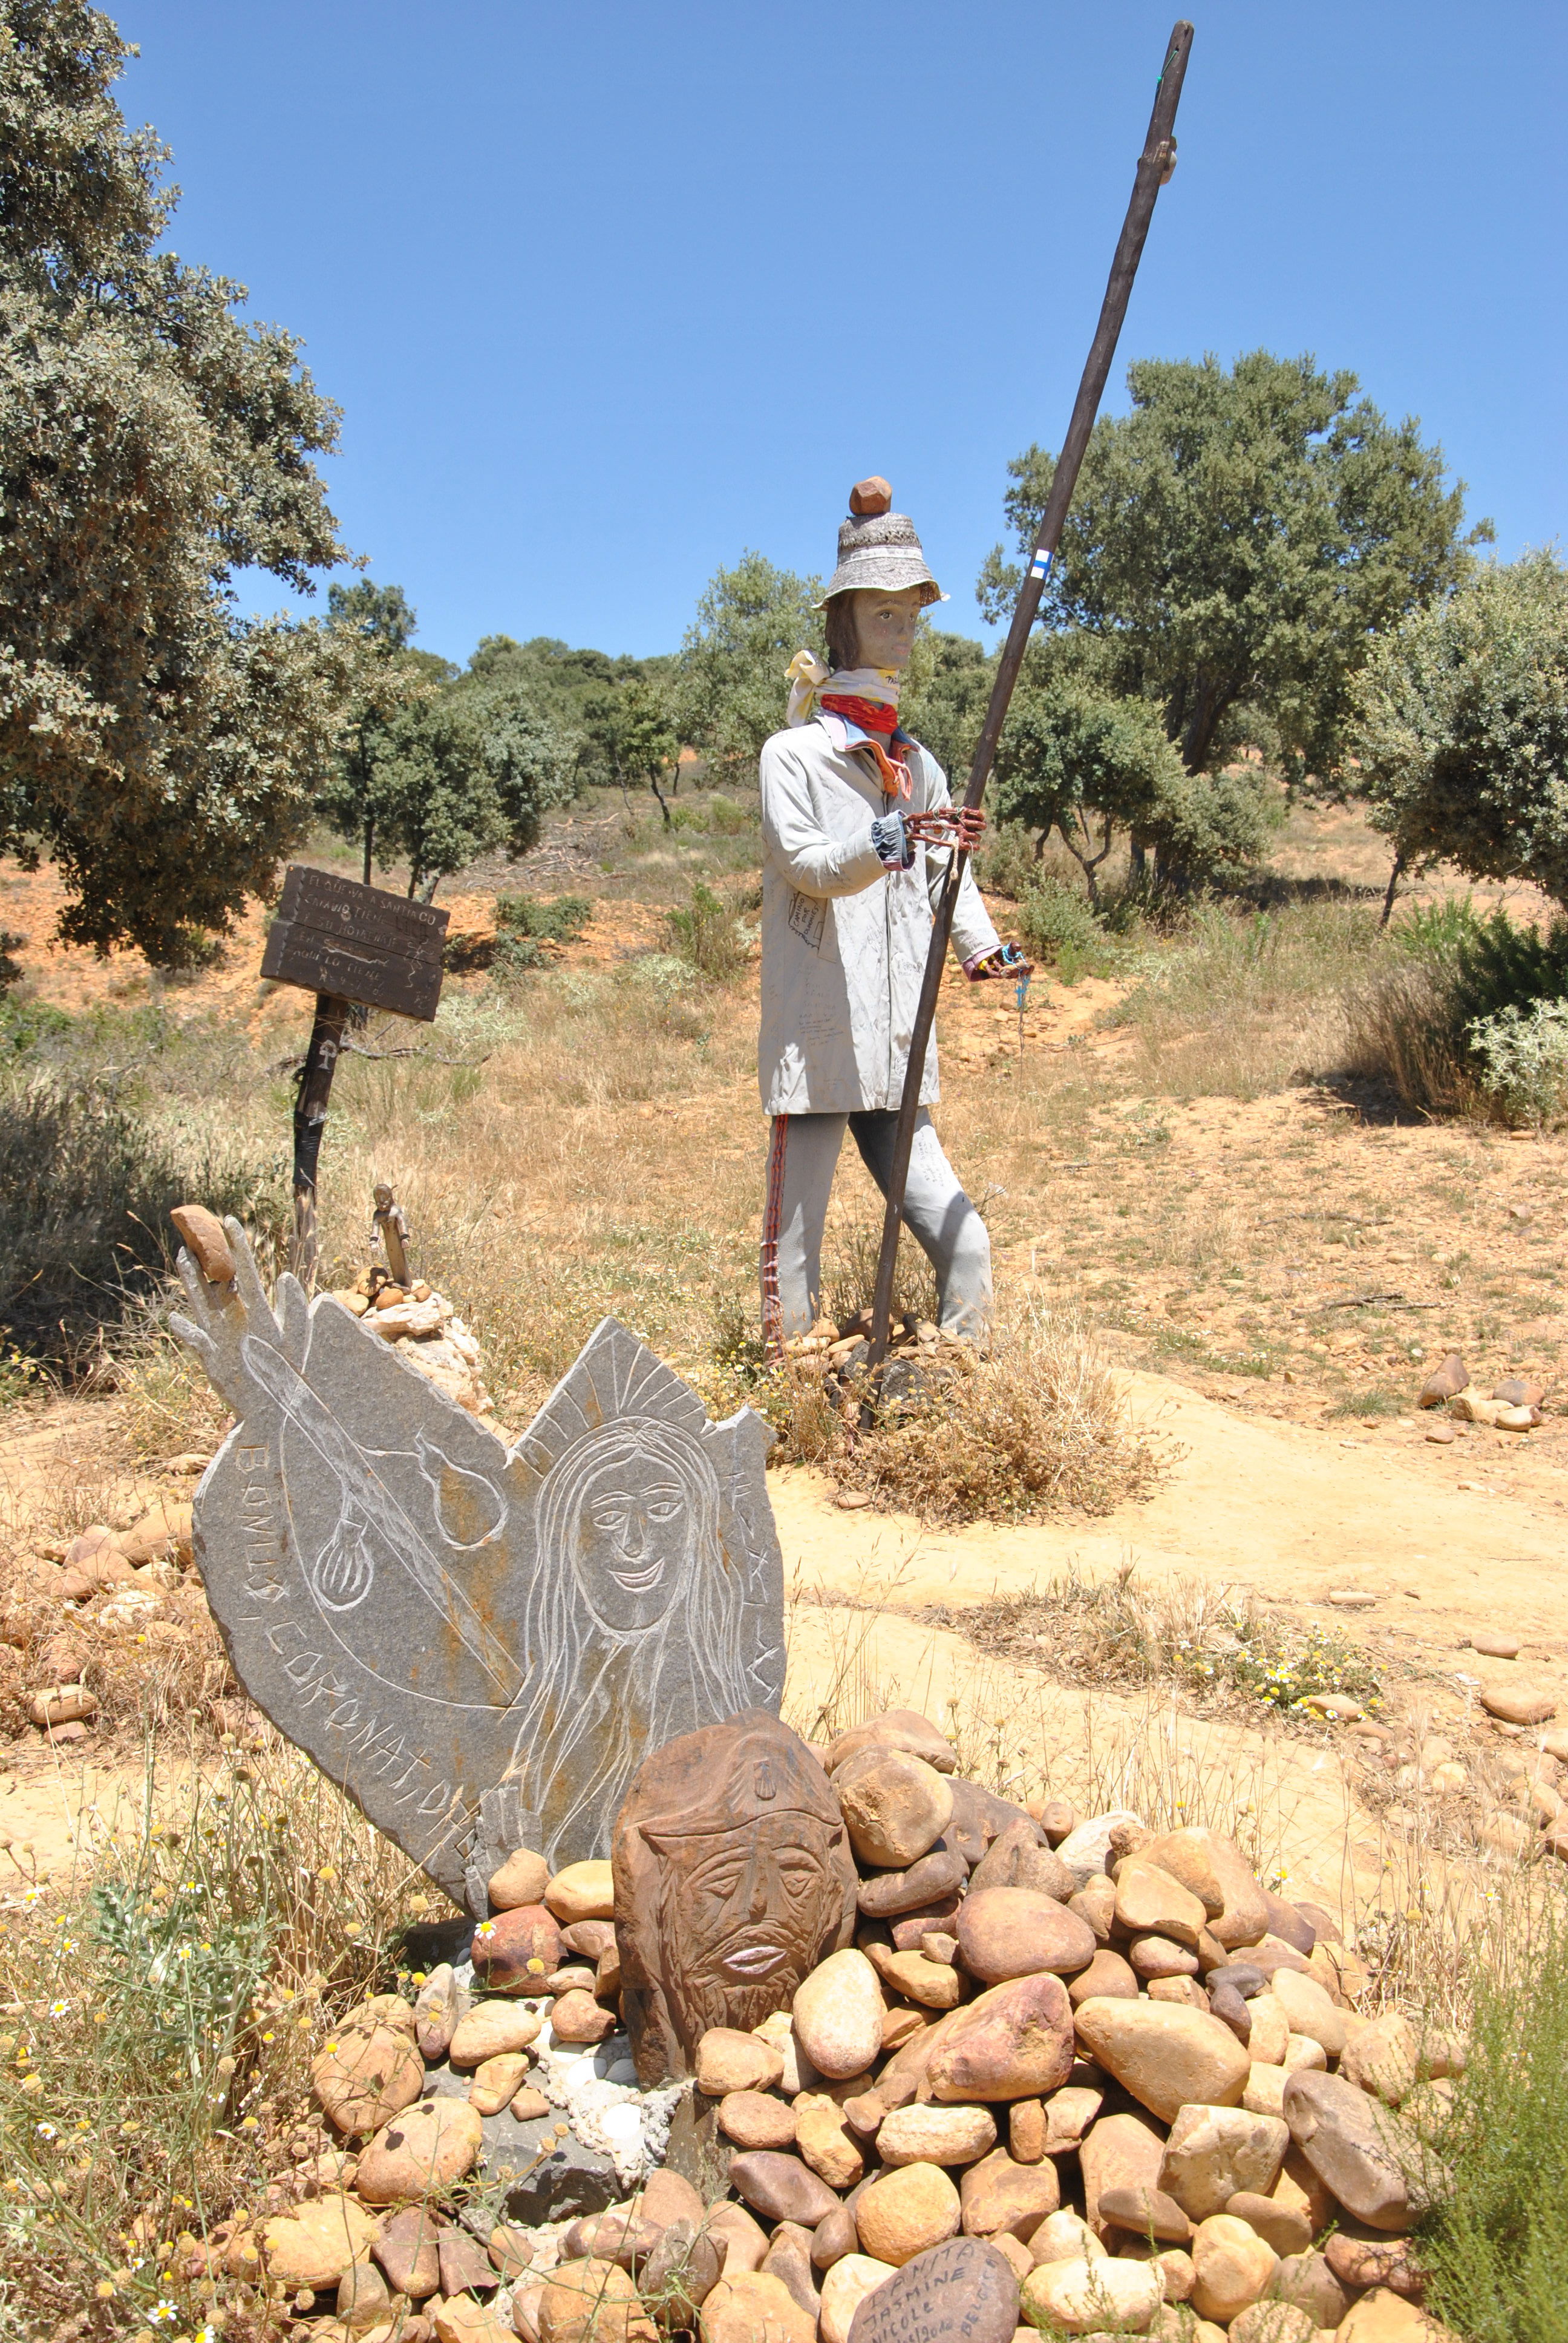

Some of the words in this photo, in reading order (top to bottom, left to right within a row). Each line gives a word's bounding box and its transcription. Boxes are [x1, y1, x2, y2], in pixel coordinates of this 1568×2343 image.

[793, 898, 805, 927] CAMINO
[802, 908, 810, 923] FOR
[862, 2266, 968, 2334] JASMINE
[867, 2242, 975, 2310] DANITA
